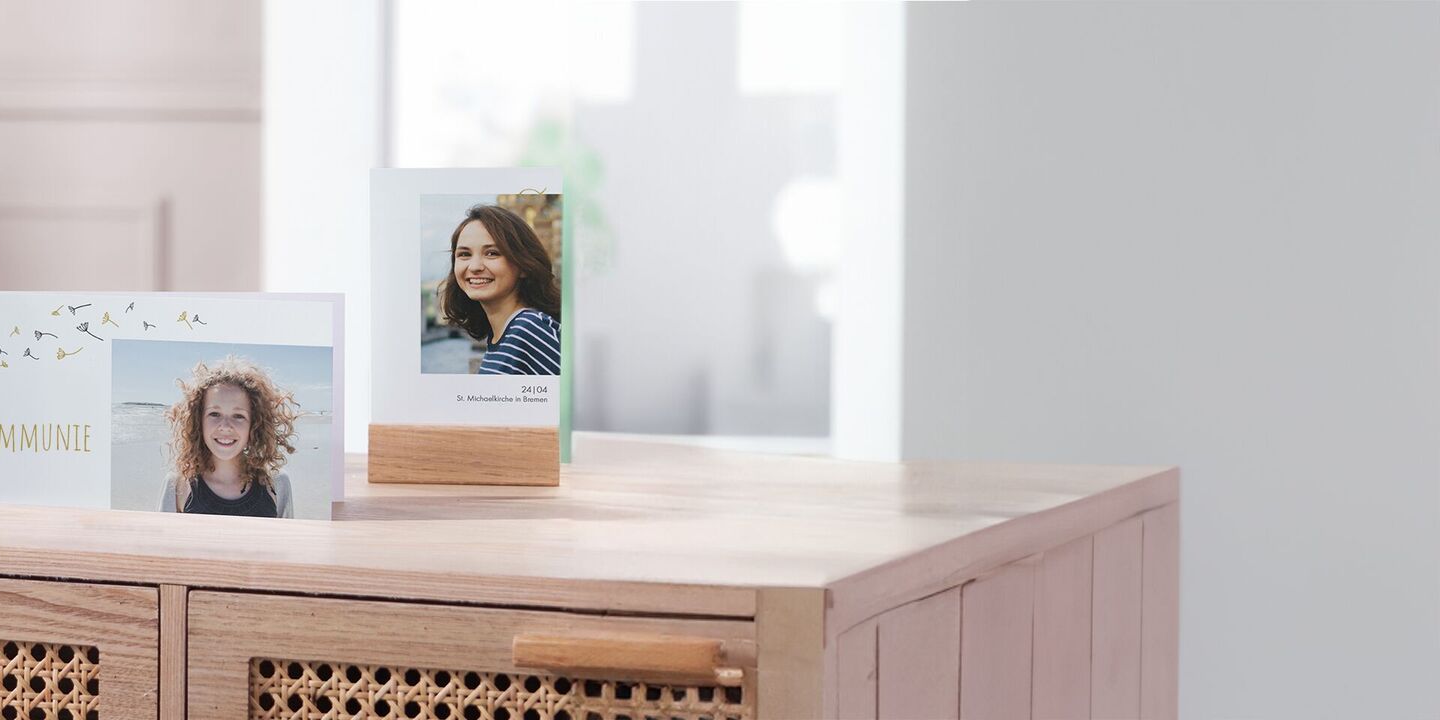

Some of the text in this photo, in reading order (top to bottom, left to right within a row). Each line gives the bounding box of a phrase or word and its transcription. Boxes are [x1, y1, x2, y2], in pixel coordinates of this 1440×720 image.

[521, 385, 548, 394] 24|04
[456, 394, 548, 403] St. Michaelkirche in Bremen
